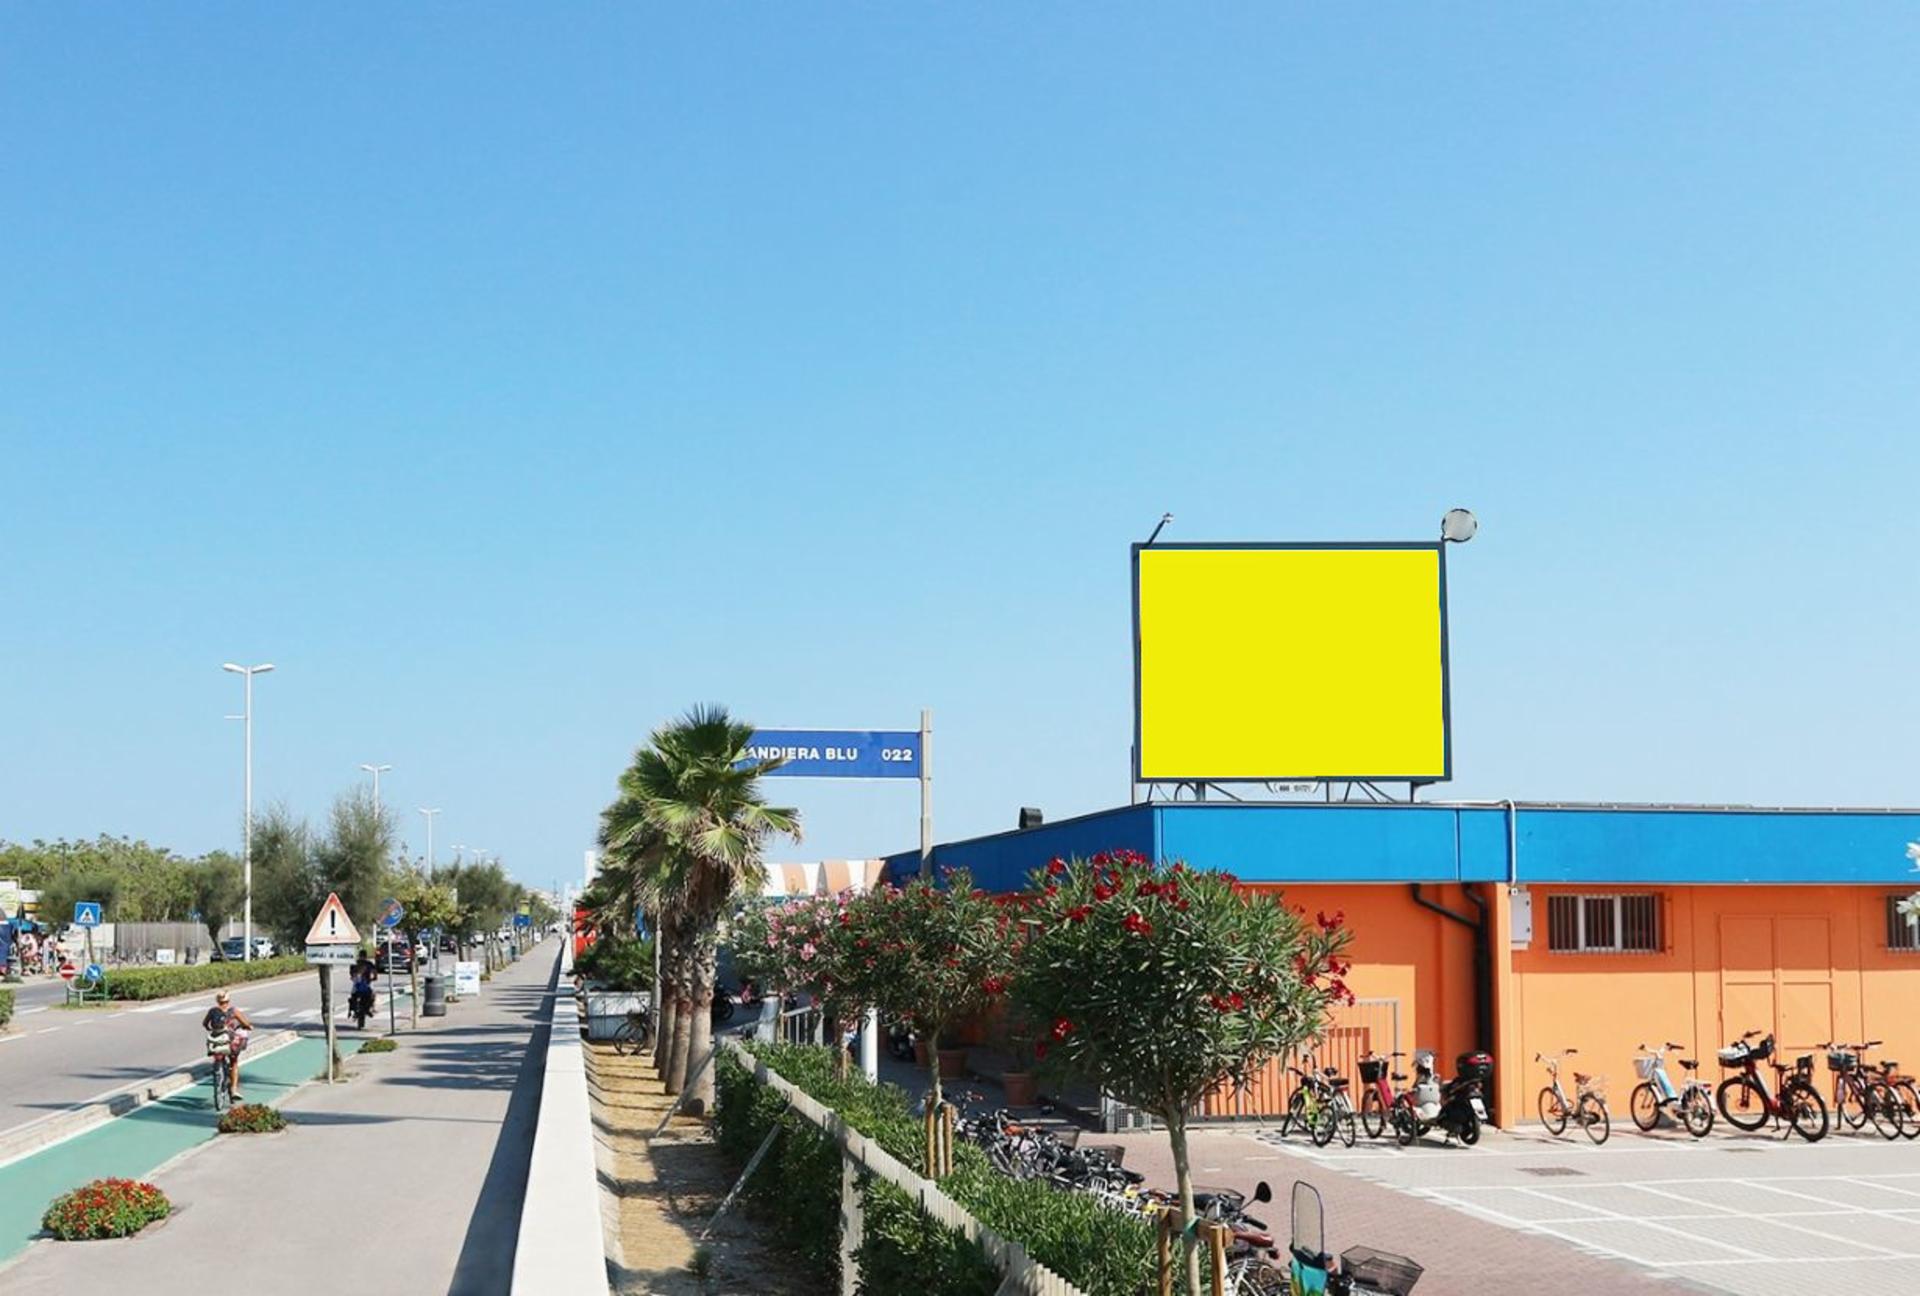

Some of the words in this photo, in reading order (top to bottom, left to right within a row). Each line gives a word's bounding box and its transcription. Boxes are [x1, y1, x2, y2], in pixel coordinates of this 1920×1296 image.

[745, 747, 820, 760] ANDIERA
[825, 748, 858, 760] BLU
[881, 749, 913, 761] 022
